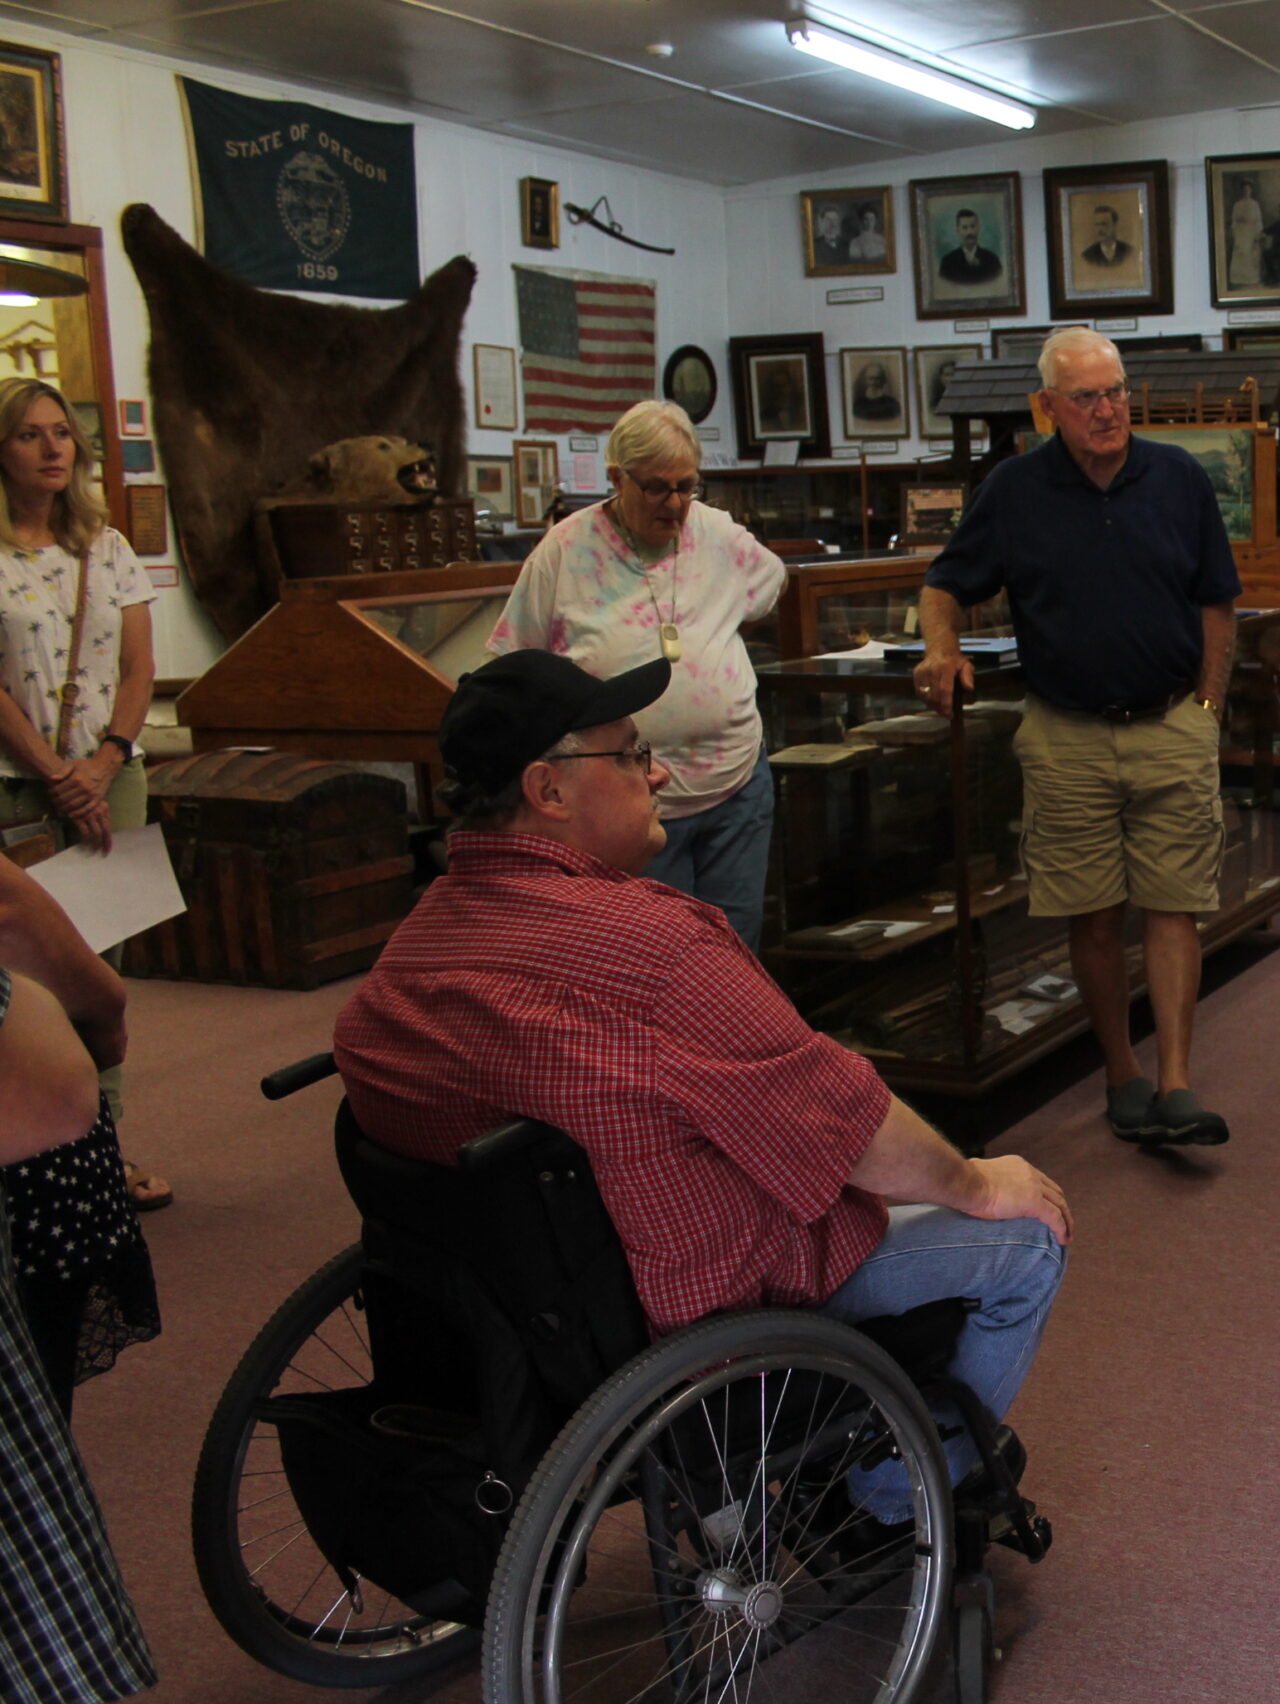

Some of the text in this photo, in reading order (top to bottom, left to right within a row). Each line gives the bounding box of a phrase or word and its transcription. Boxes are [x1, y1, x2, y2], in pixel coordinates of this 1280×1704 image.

[225, 123, 387, 183] STATE OF OREGON
[296, 262, 339, 281] 1859
